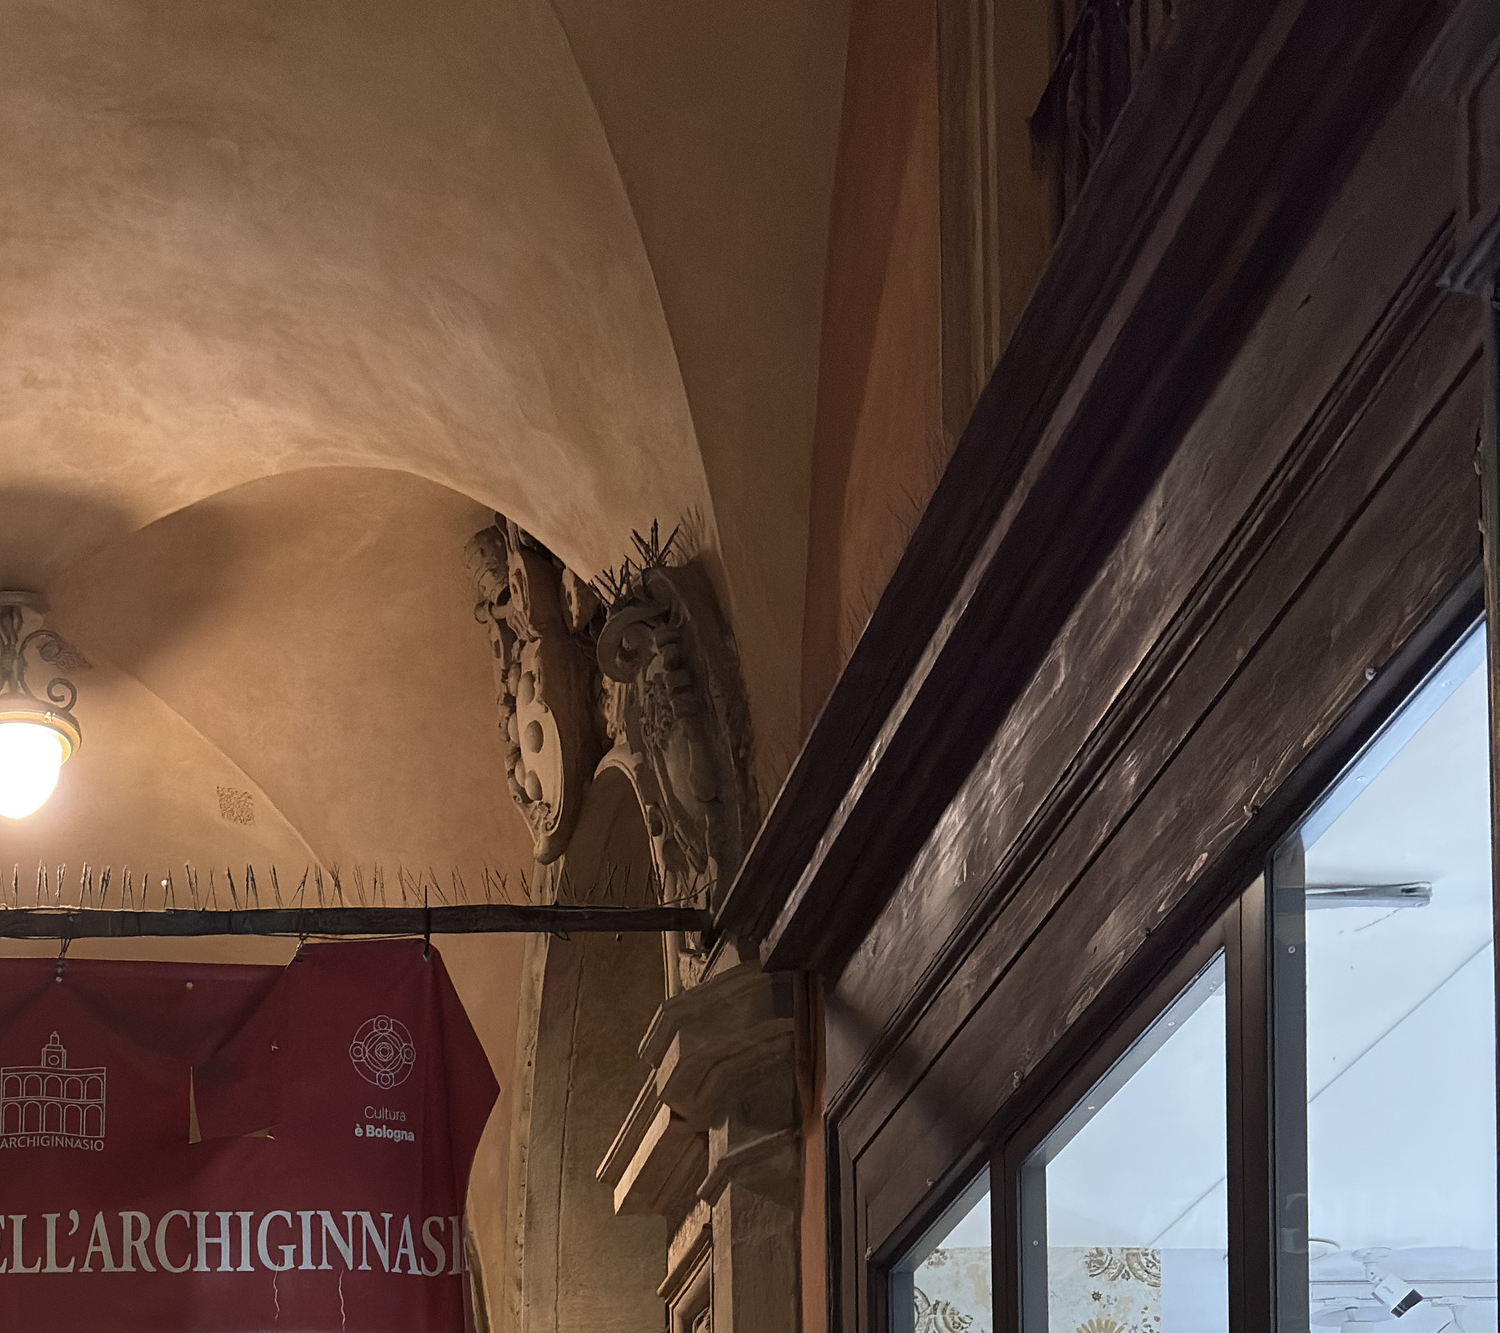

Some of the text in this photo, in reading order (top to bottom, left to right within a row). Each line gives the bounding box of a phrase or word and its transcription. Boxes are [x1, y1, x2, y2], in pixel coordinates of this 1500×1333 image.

[364, 1105, 406, 1122] Cultura
[354, 1123, 415, 1142] è Bologna
[0, 1135, 105, 1152] ARCHIGINNASIO
